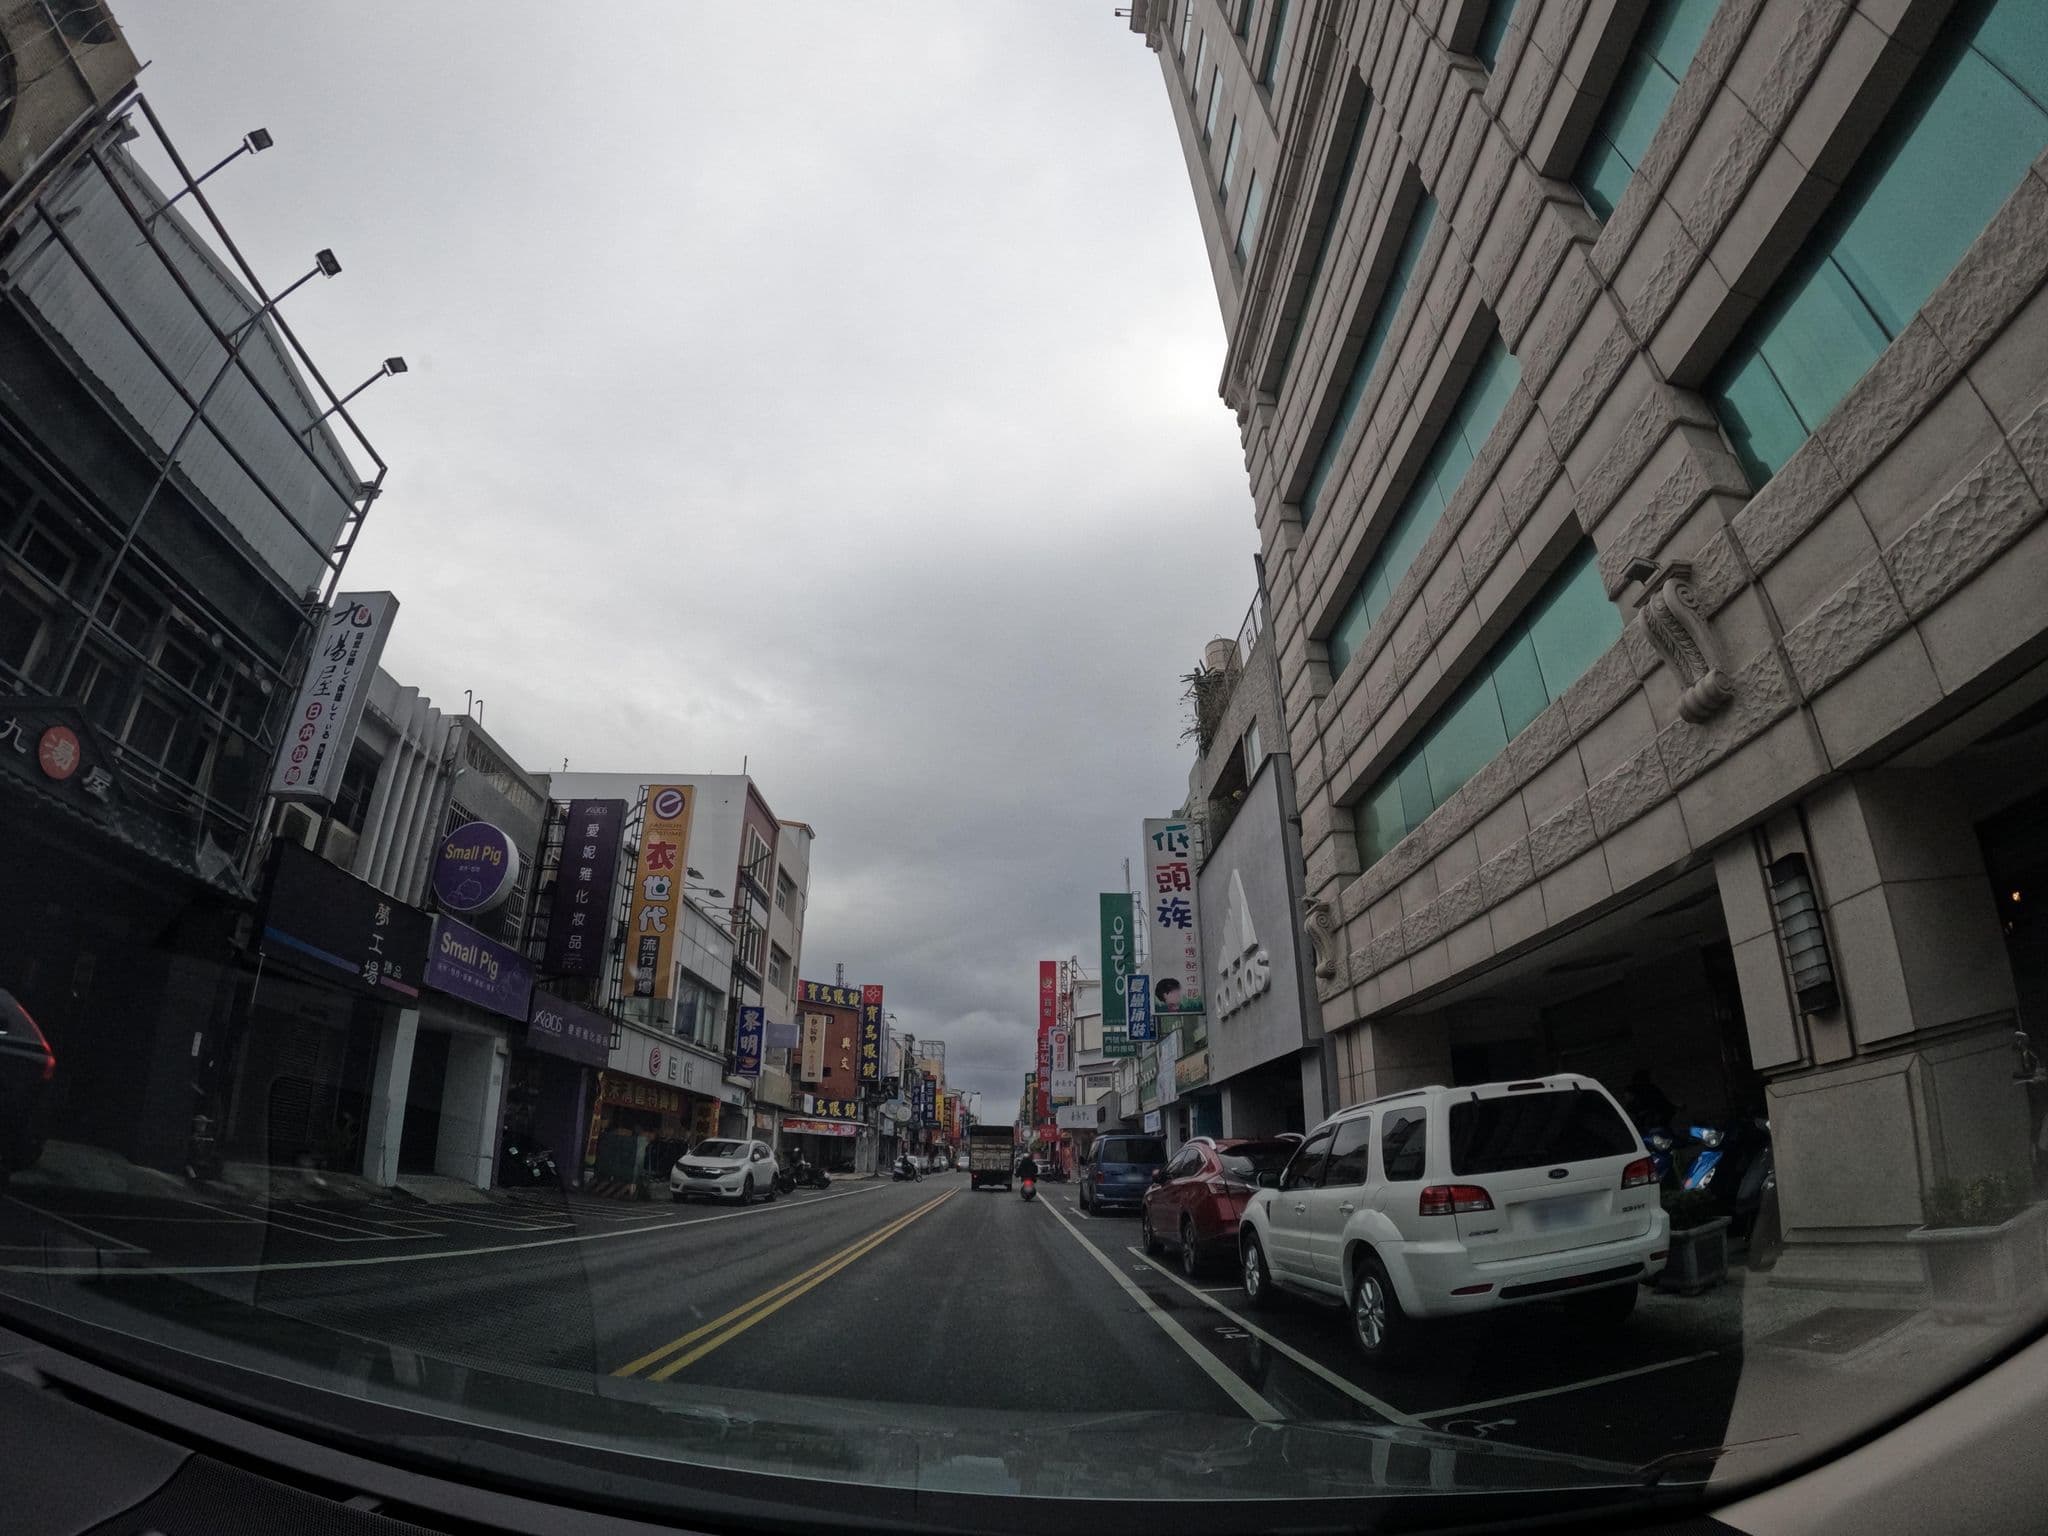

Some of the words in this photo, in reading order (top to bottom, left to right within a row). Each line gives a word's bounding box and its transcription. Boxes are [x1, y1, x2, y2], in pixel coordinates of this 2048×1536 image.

[308, 600, 372, 697] 九湯屋
[445, 844, 479, 862] Small
[480, 845, 502, 866] Pig
[568, 823, 600, 950] 愛妮雅化妝品
[638, 841, 676, 932] 衣世代
[1152, 824, 1193, 929] 低頭族
[362, 902, 392, 986] 夢工場
[440, 931, 479, 967] Small
[479, 950, 499, 981] Pig
[1110, 916, 1126, 995] oppo
[807, 983, 860, 1009] 寶島眼鏡
[1216, 950, 1270, 1022] adidas
[740, 1010, 761, 1056] 黎明
[863, 1005, 879, 1079] 寶島眼鏡
[815, 1099, 857, 1120] 島眼鏡
